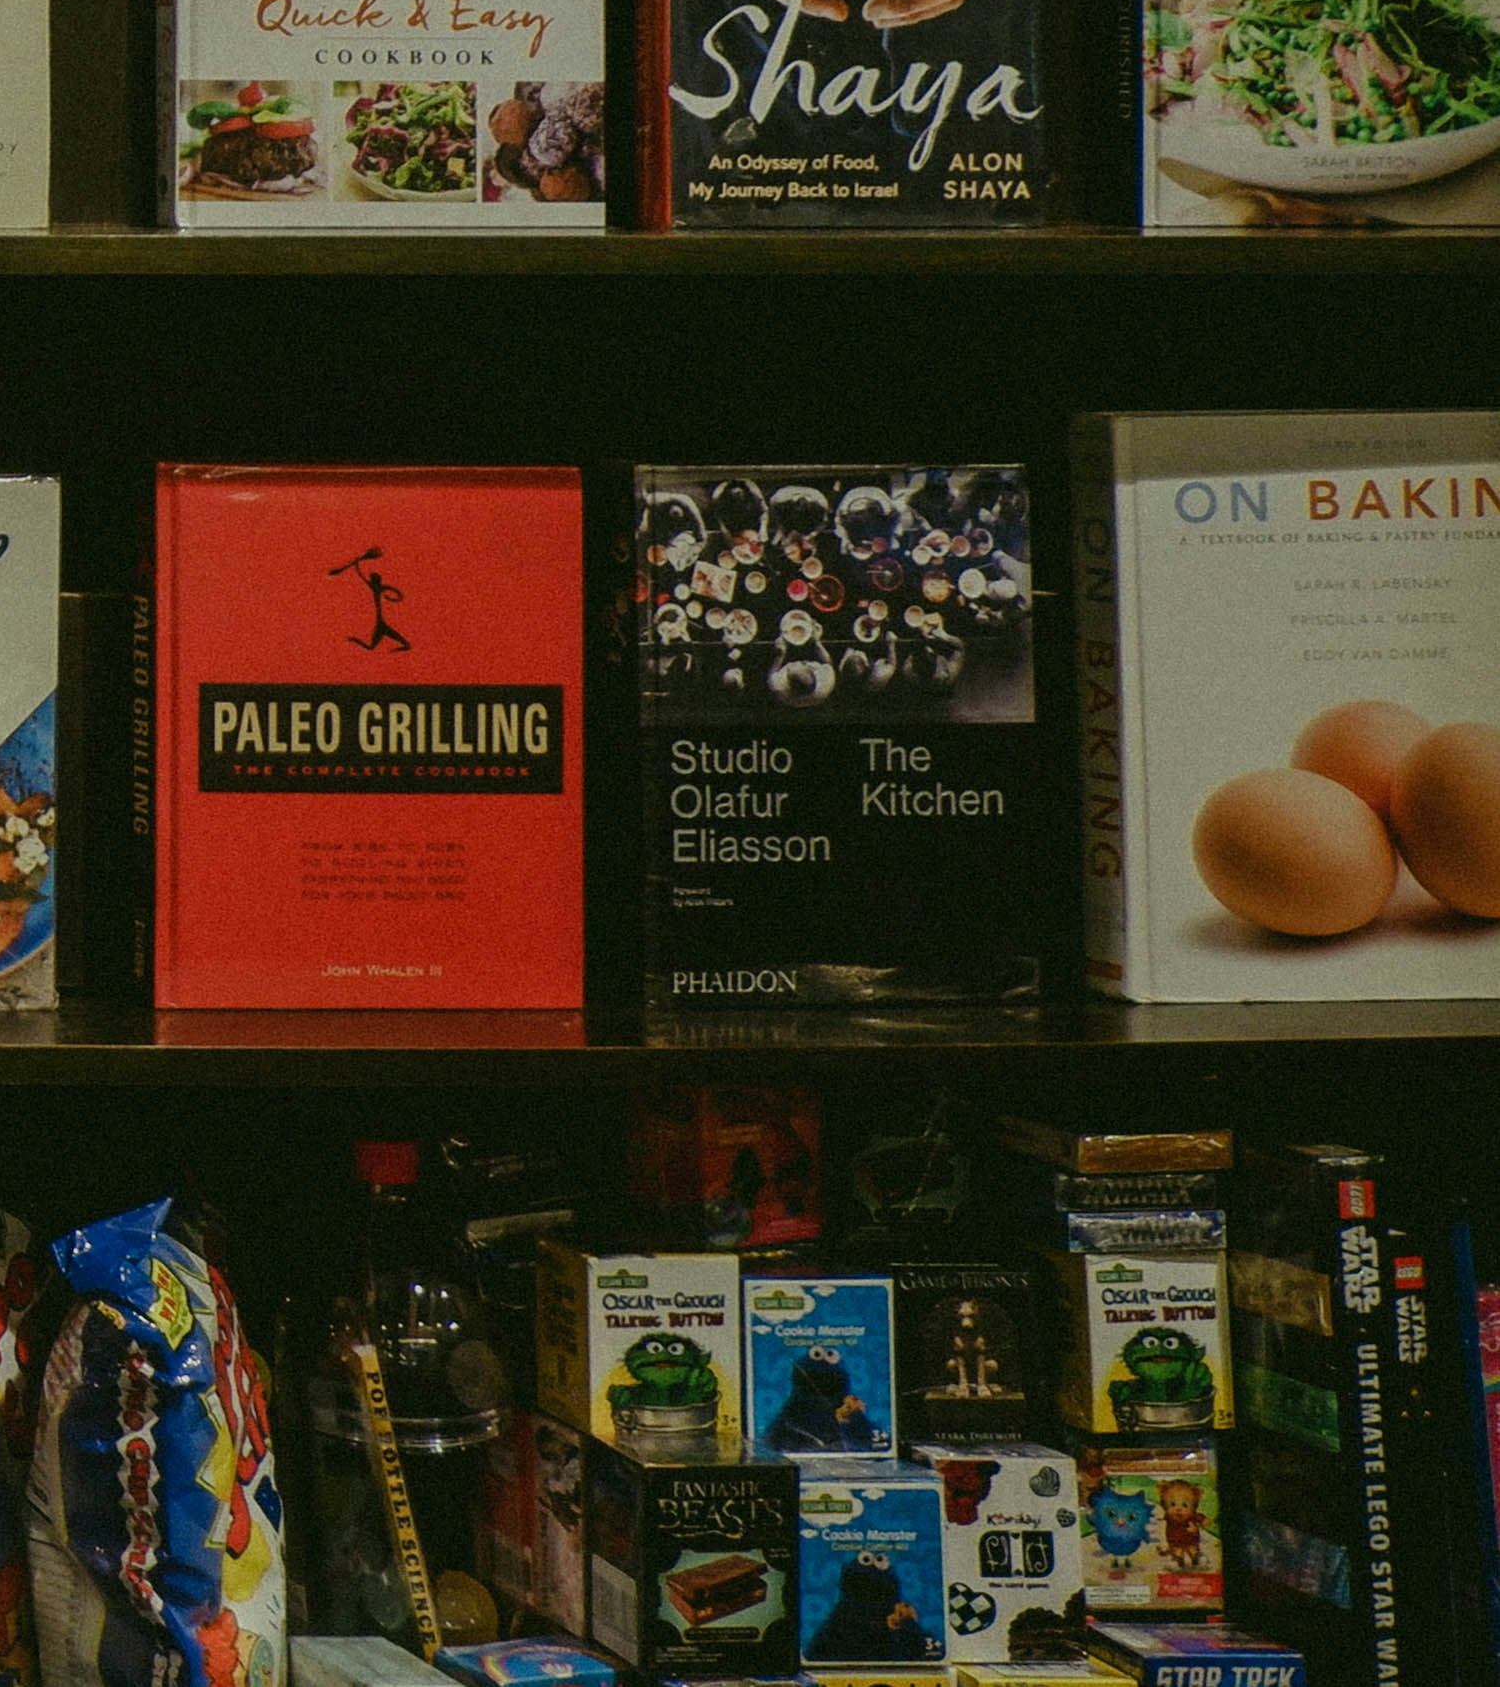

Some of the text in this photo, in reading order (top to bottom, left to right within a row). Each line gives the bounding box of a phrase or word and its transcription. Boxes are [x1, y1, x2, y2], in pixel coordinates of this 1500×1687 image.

[315, 49, 496, 66] COOKBOOK
[709, 153, 879, 175] An Odyssey of Food,
[949, 152, 1024, 172] ALON
[689, 181, 899, 202] My Journey Back to Israel
[943, 180, 1031, 200] SHAYA
[213, 701, 550, 757] PALEO GRILLING
[671, 739, 793, 775] Studio
[859, 737, 933, 771] The
[233, 764, 531, 778] THE COMPLETE COOKBOOK
[671, 784, 790, 819] Olafur
[861, 782, 1005, 816] Kitchen
[672, 829, 832, 863] Eliasson
[672, 967, 798, 994] PHAIDON
[1105, 1306, 1217, 1325] TALKING BUTTON
[1356, 1343, 1395, 1630] ULTIMATE LEGO STAR
[820, 1528, 917, 1543] Cookie Monster
